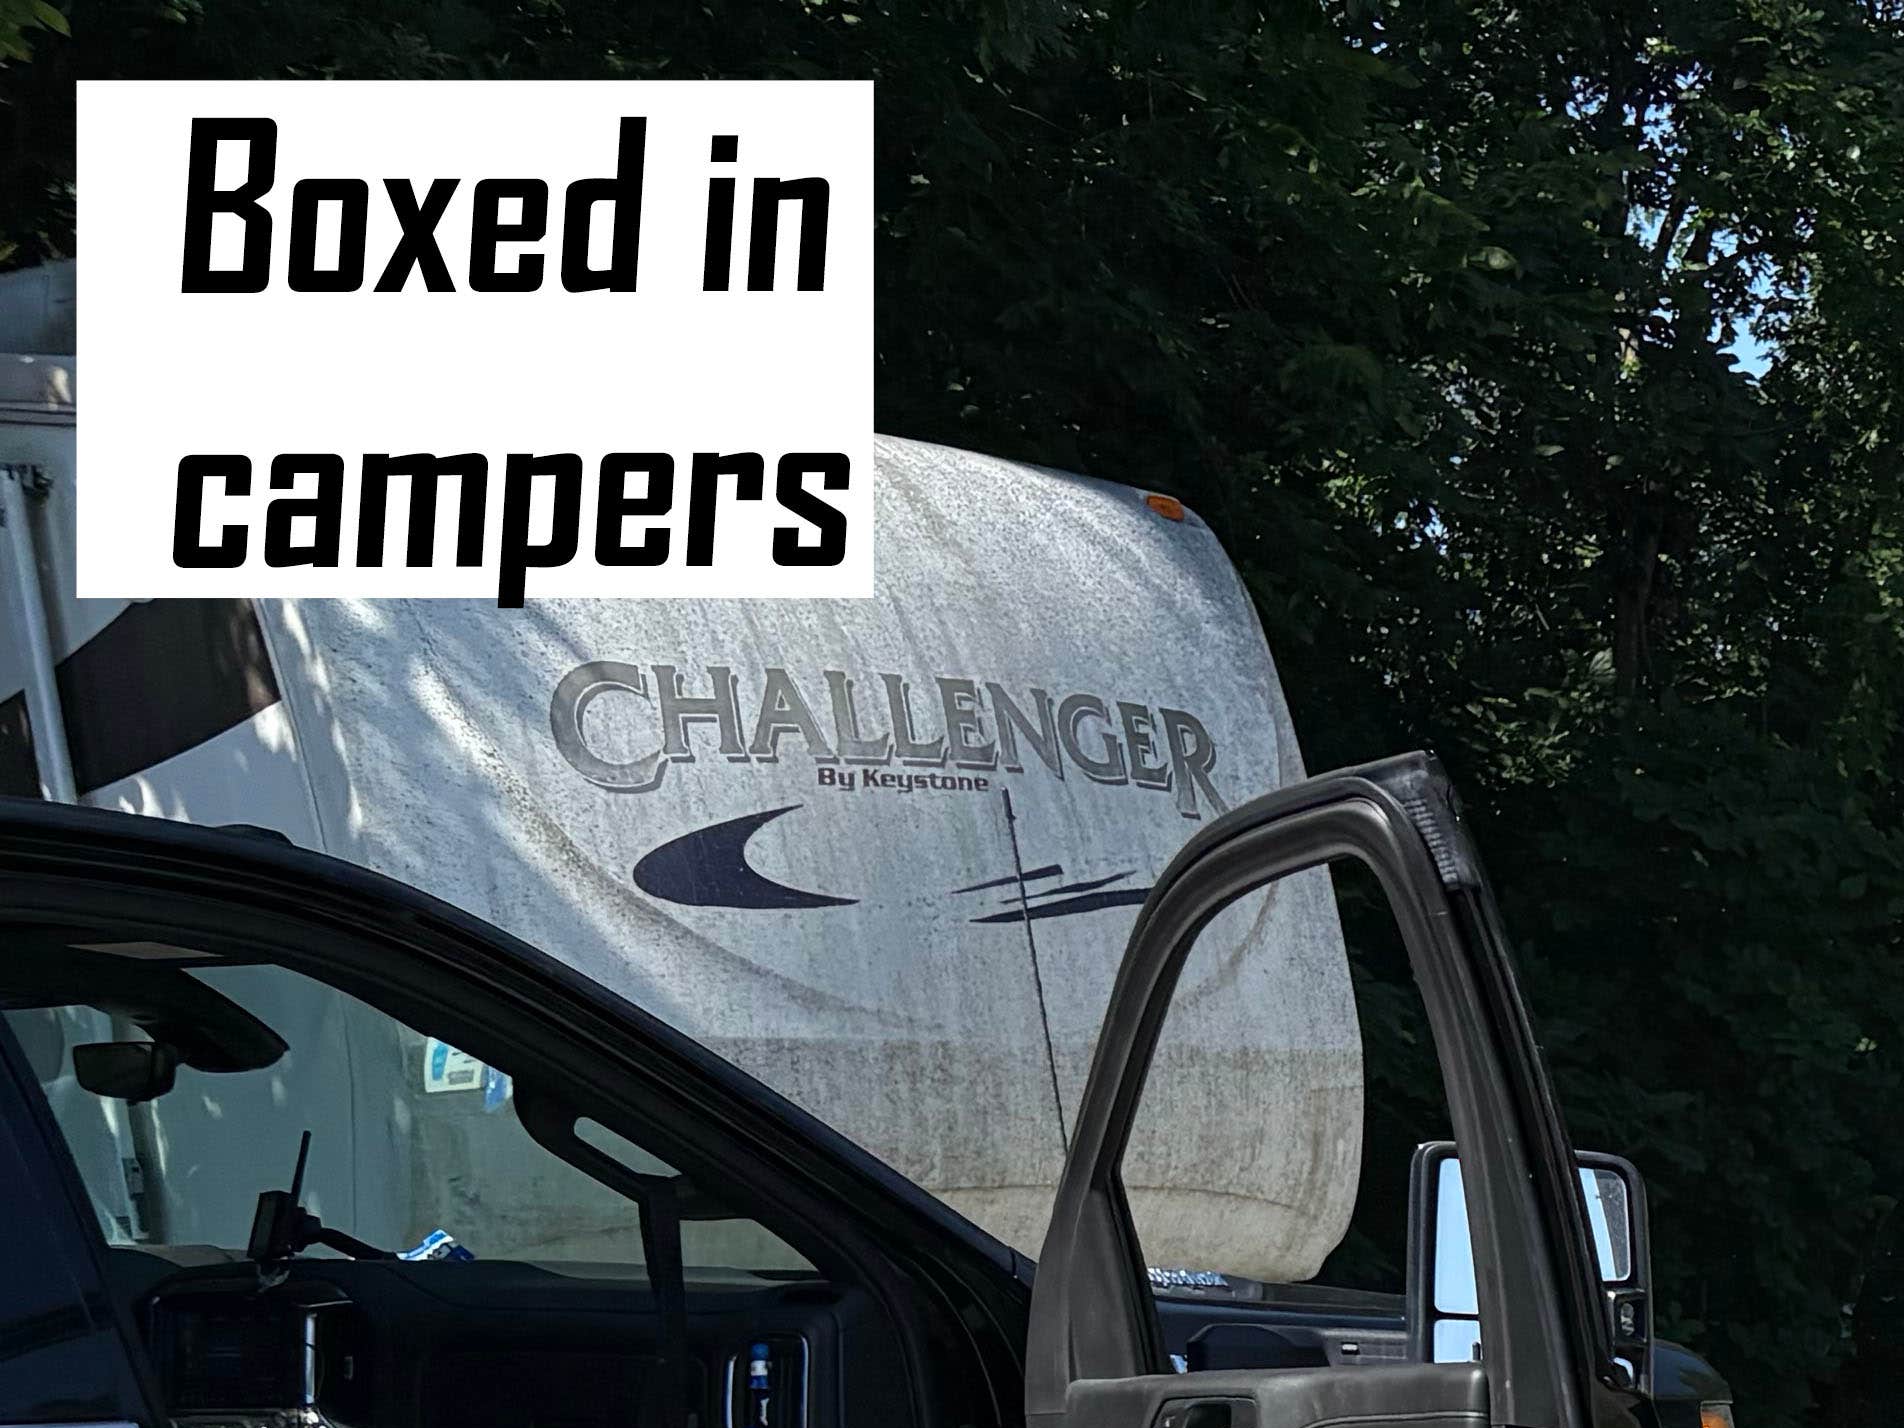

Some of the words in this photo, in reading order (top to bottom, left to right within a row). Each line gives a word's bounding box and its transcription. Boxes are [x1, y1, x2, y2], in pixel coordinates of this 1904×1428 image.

[550, 660, 1230, 822] CHALLENGER
[817, 768, 855, 791] By
[862, 768, 991, 793] Keystone
